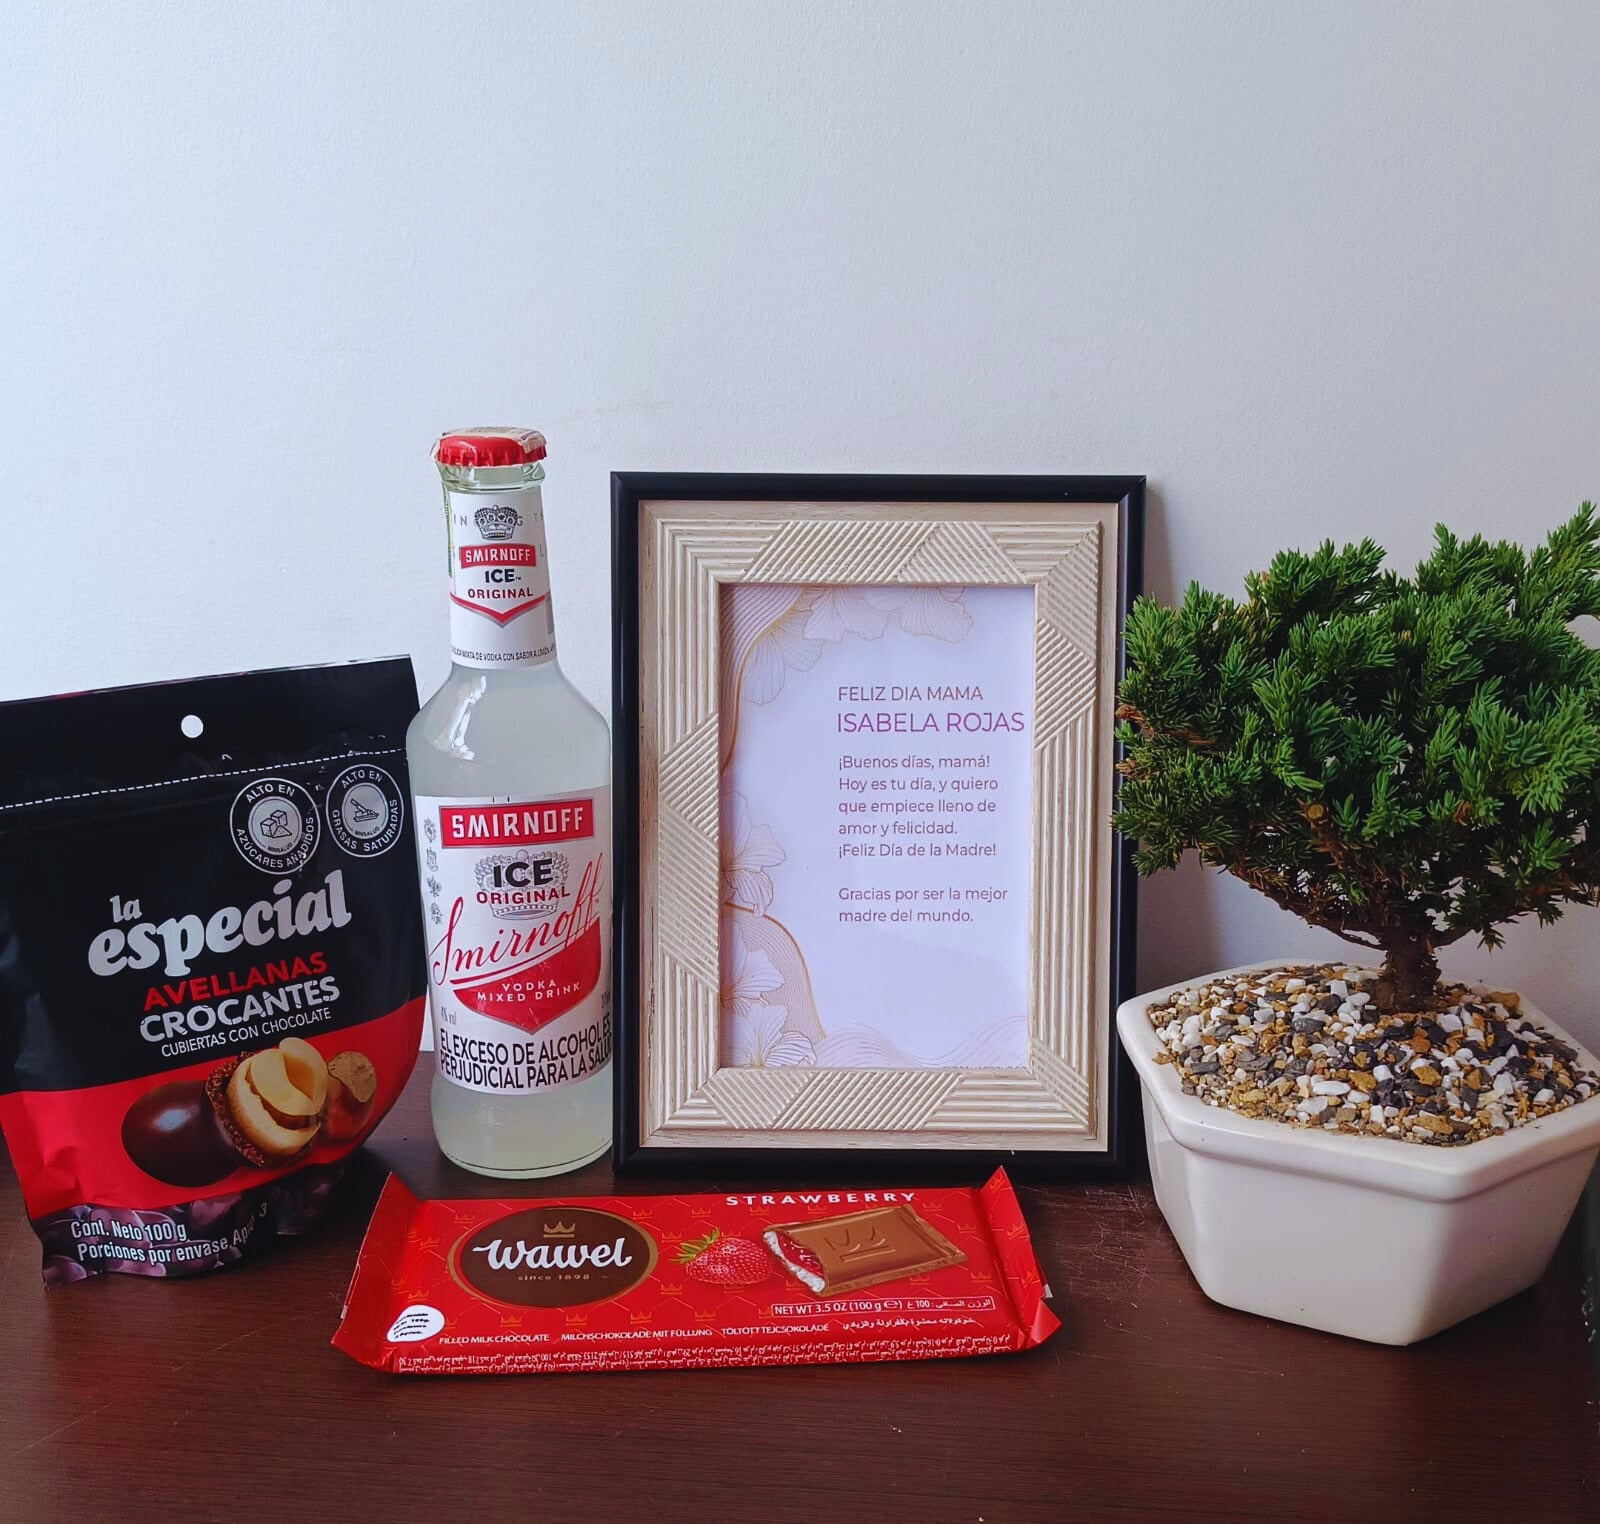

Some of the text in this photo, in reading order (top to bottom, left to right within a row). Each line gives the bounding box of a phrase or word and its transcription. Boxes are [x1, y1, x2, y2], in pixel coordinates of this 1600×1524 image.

[465, 548, 531, 563] SMIRNOFF
[468, 587, 533, 599] ORIGINAL
[484, 653, 502, 661] VODKA
[502, 652, 515, 661] CON
[838, 686, 983, 701] FELIZ DIA MAMA
[837, 712, 1025, 733] ISABELA ROJAS
[839, 755, 990, 771] ¡Buenos días, mamá!
[341, 769, 383, 788] ALTO EN
[839, 777, 999, 793] Hoy es tu día, y quiero
[245, 784, 296, 803] ALTO EN
[838, 799, 997, 815] que empiece lleno de
[332, 809, 358, 850] GRASAS
[363, 799, 398, 852] SATURADAS
[452, 807, 585, 839] SMIRNOFF
[838, 821, 958, 837] amor y felicidad.
[236, 828, 284, 868] AZÚCARES
[839, 843, 997, 858] ¡Feliz Día de la Madre!
[493, 859, 553, 888] ICE
[476, 885, 571, 905] ORIGINAL
[838, 887, 1008, 904] Gracias por ser la mejor
[110, 895, 143, 924] la
[430, 852, 604, 985] Smirnoff
[839, 909, 973, 922] madre del mundo.
[88, 869, 352, 977] especial
[144, 951, 328, 1012] AVELLANAS
[502, 979, 557, 992] VODKA
[477, 982, 581, 1003] MIXED DRINK
[140, 976, 340, 1042] CROCANTES
[161, 1007, 332, 1057] CUBIERTAS CON CHOCOLATE
[440, 1012, 611, 1066] EL EXCESO DE ALCOHOL ES
[440, 1050, 524, 1089] PERJUDICIAL
[527, 1060, 569, 1089] PARA
[571, 1054, 587, 1079] LA
[725, 1192, 917, 1206] STRAWBERRY
[71, 1221, 188, 1242] Cont. Neto 100 g
[77, 1242, 146, 1262] Porciones
[149, 1248, 172, 1266] por
[176, 1237, 228, 1262] envase
[472, 1237, 633, 1270] Wawel
[774, 1305, 794, 1315] NET
[795, 1304, 812, 1314] WT
[815, 1303, 831, 1313] 3.5
[833, 1302, 847, 1312] OZ
[850, 1301, 873, 1312] (100
[874, 1302, 882, 1312] g
[916, 1300, 930, 1309] 100
[439, 1335, 469, 1344] FILLED
[470, 1335, 494, 1344] MILK
[495, 1333, 550, 1343] CHOCOLATE
[561, 1330, 651, 1341] MILCHSCHOKOLADE
[652, 1329, 668, 1338] MIT
[671, 1327, 713, 1338] FÜLLUNG
